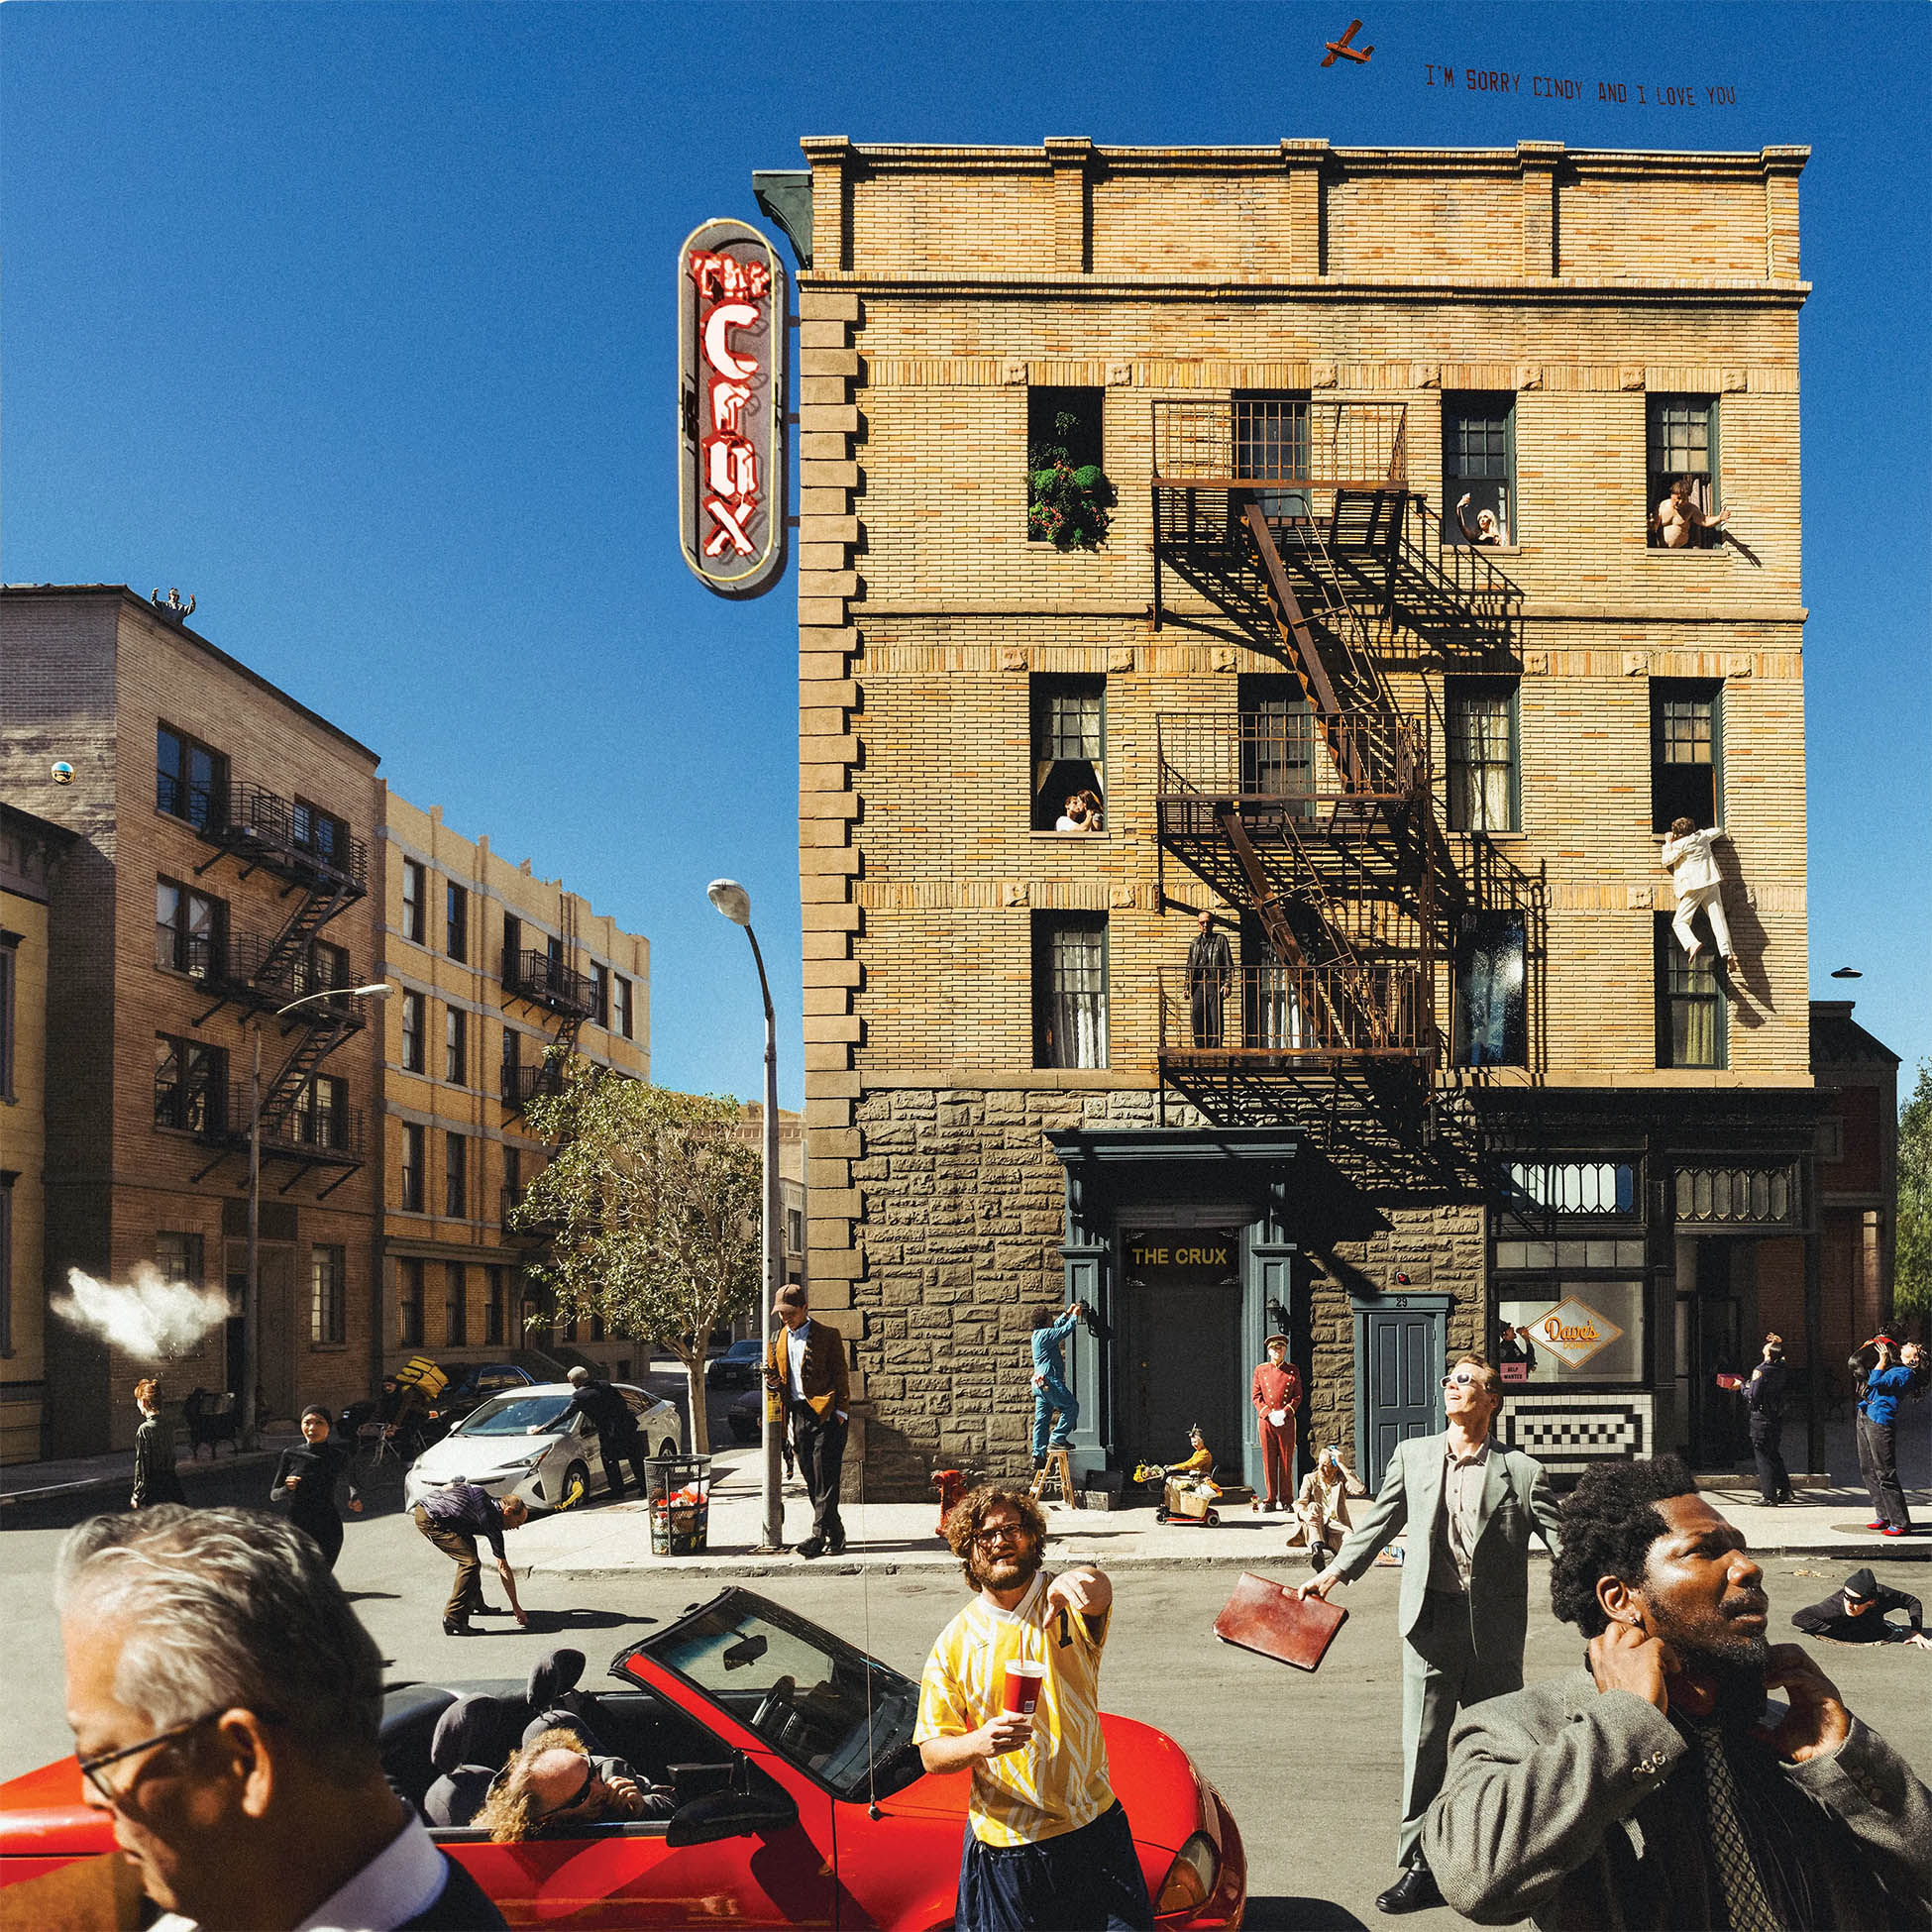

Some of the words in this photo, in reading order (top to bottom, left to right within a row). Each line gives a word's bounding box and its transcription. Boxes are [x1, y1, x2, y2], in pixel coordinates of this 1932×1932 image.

[1425, 63, 1454, 88] I'M
[1466, 68, 1521, 94] SORRY
[1533, 76, 1583, 100] CINDY
[1598, 81, 1628, 104] AND
[1637, 84, 1648, 105] I
[1657, 86, 1697, 106] LOVE
[1705, 85, 1736, 106] YOU
[688, 250, 772, 299] The
[1132, 1247, 1170, 1265] THE
[1175, 1247, 1229, 1265] CRUX
[1396, 1296, 1408, 1308] 29
[1545, 1316, 1601, 1342] Dave's
